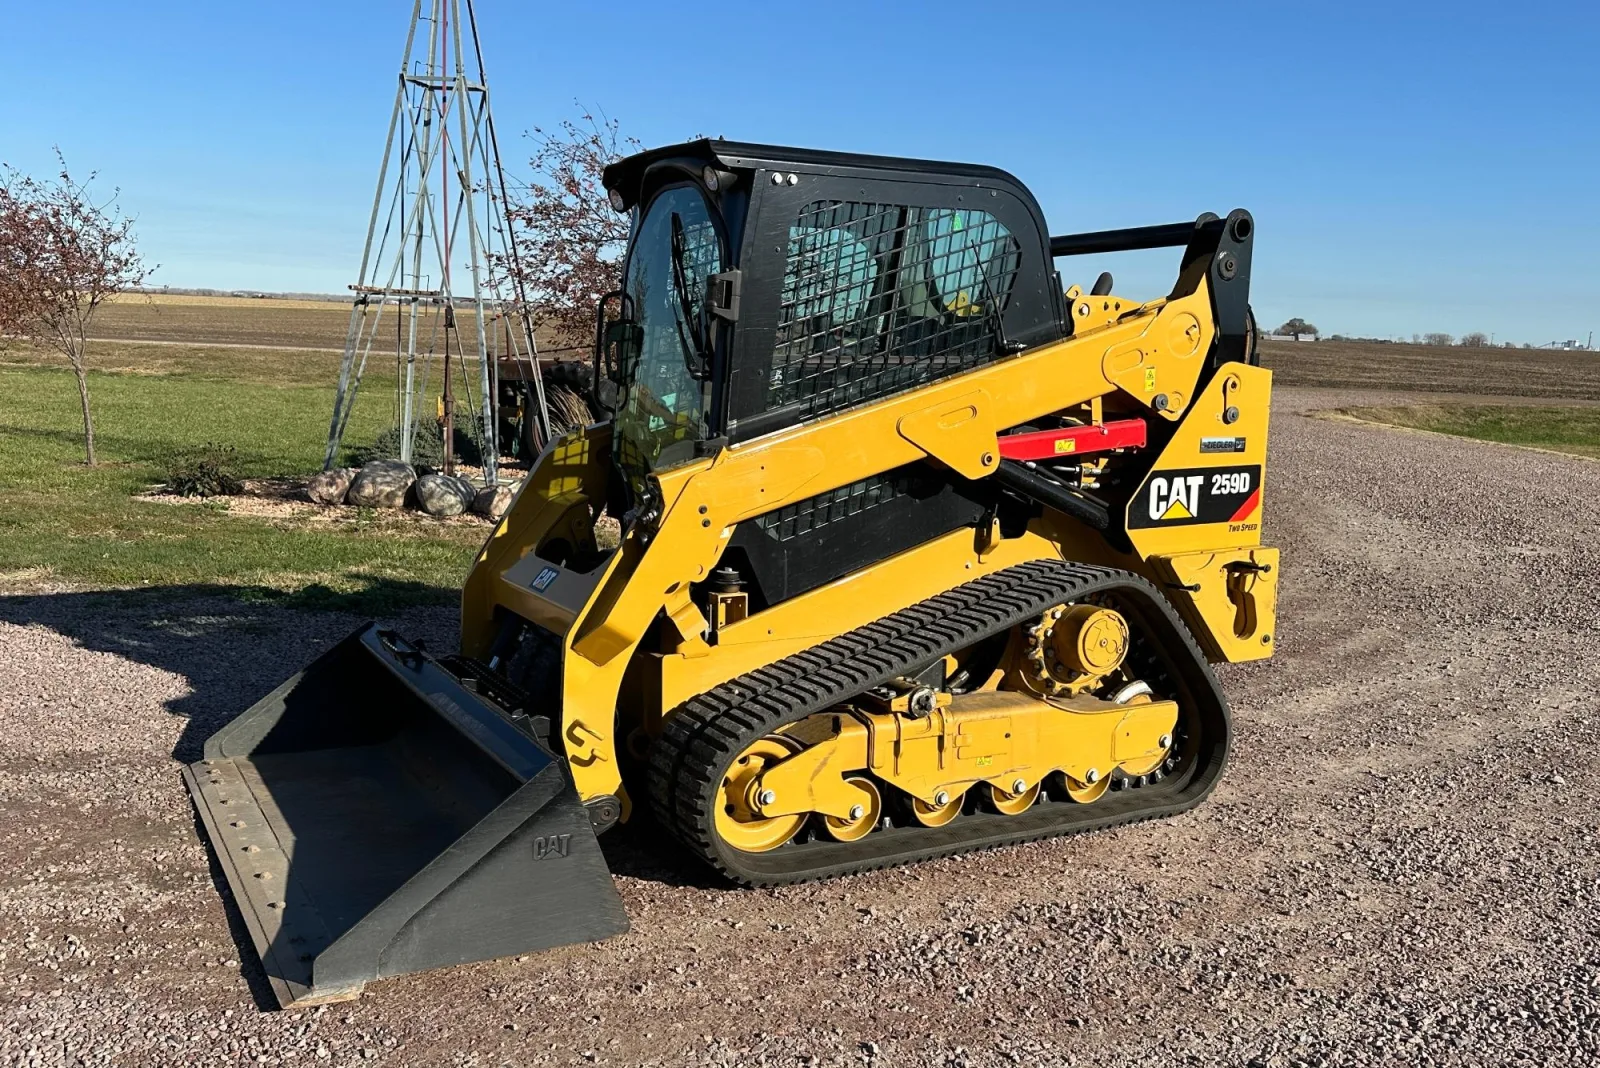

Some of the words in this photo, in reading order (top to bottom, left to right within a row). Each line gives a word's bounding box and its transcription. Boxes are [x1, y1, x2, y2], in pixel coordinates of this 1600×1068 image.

[1149, 475, 1204, 520] CAT
[1211, 472, 1250, 495] 259D
[532, 568, 557, 590] CAT
[533, 834, 571, 860] CAT
